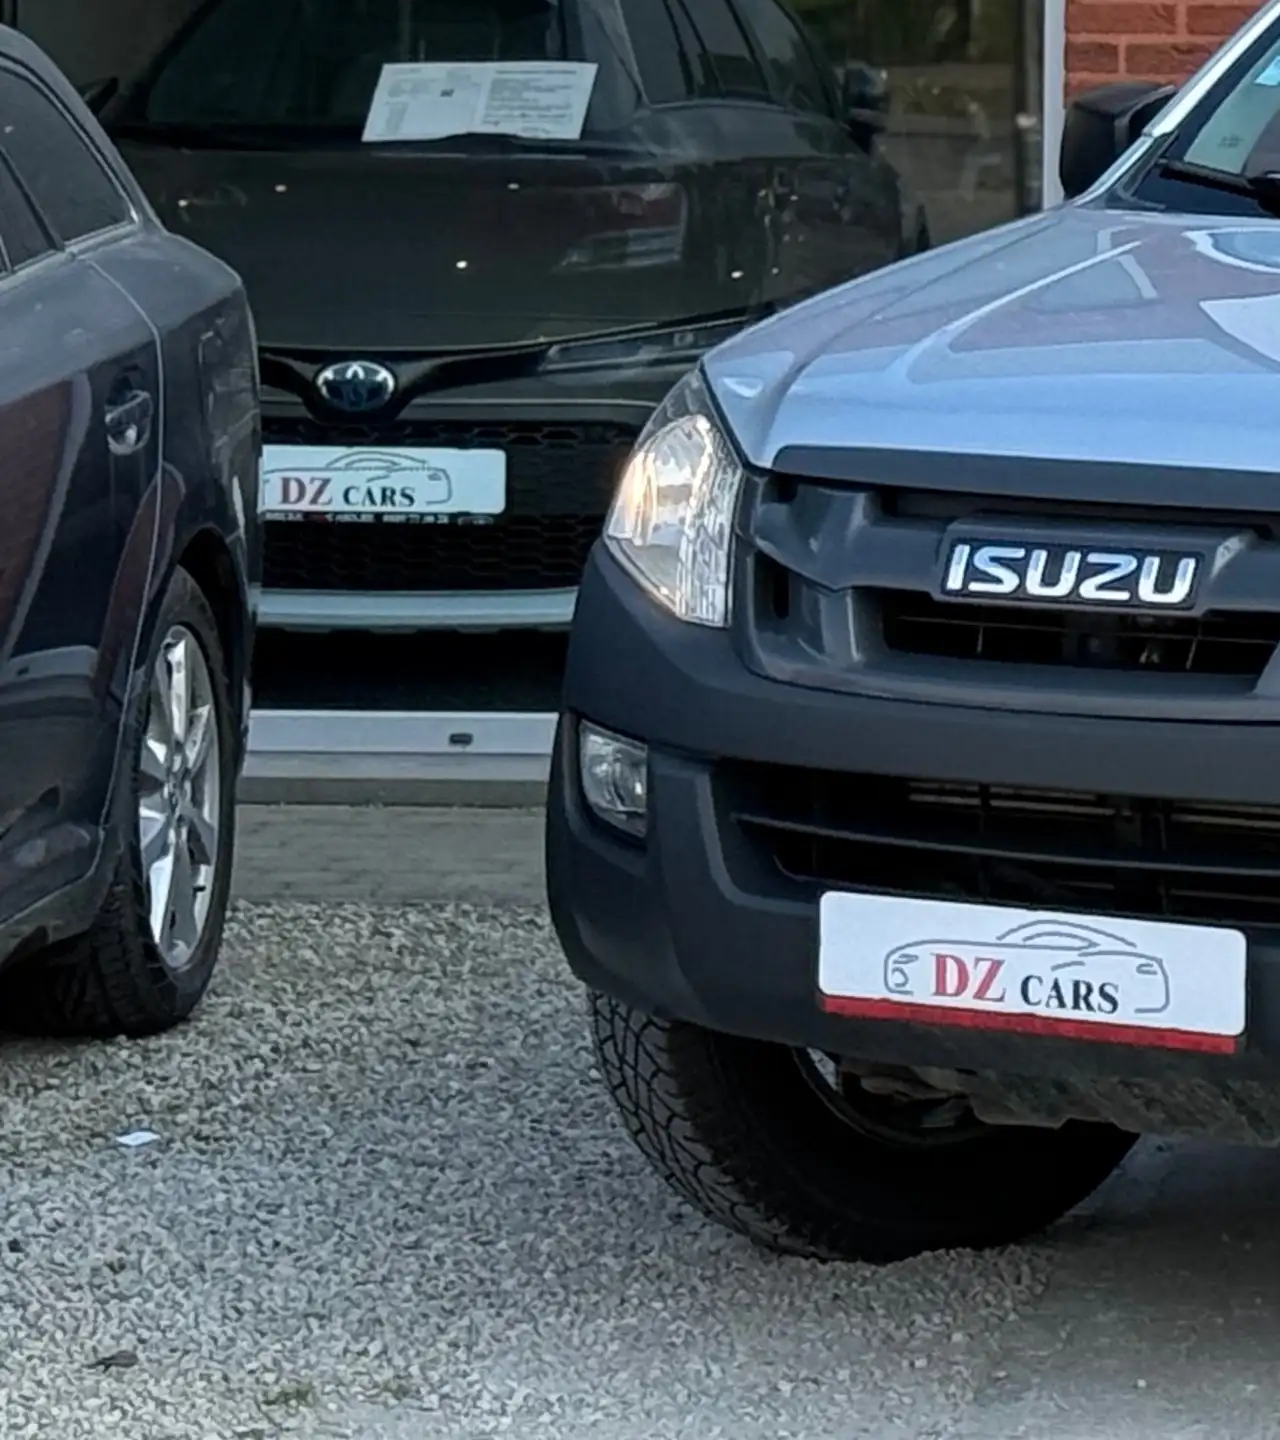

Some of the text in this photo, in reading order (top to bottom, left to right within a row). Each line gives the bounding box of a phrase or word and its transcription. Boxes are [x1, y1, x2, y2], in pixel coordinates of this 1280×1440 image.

[279, 476, 416, 508] DZ CARS
[946, 543, 1197, 604] ISUZU
[930, 951, 1120, 1015] DZ CARS
